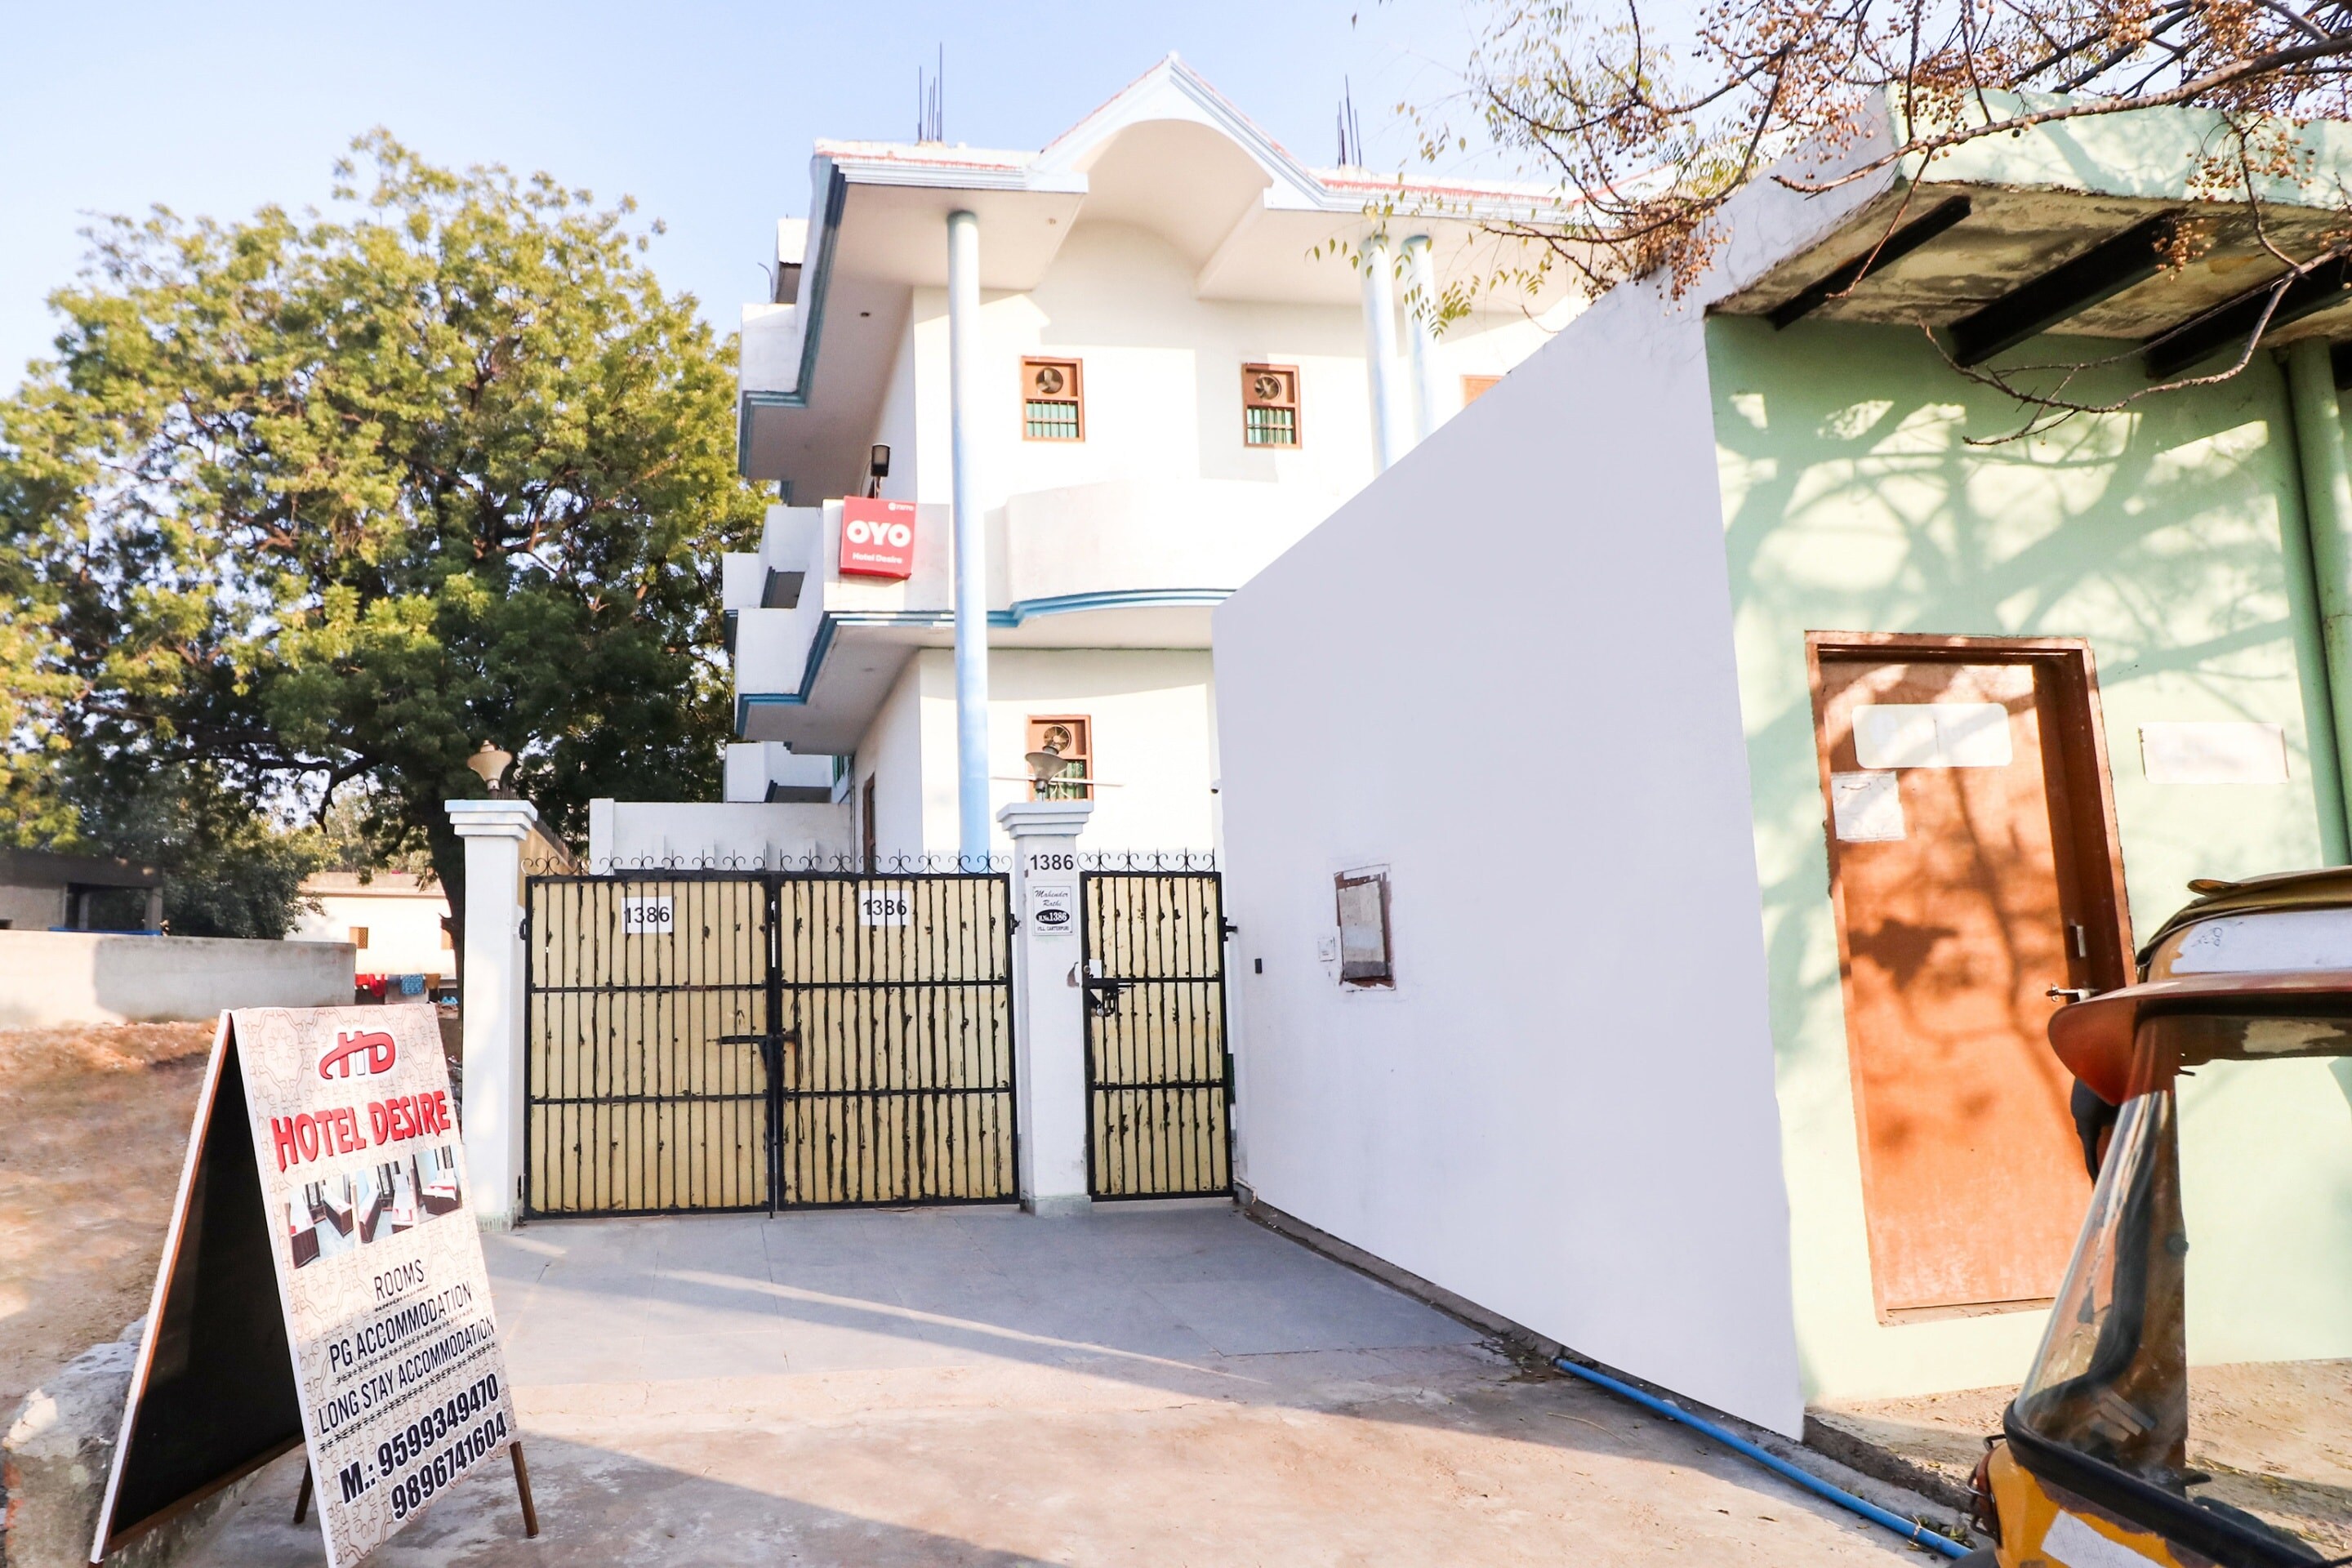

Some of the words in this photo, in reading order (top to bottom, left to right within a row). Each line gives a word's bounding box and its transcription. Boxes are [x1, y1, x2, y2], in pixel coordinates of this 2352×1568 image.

[846, 520, 911, 548] OYO
[852, 552, 875, 562] Hotel
[875, 554, 902, 564] Desire
[1030, 854, 1074, 871] 1386
[624, 906, 670, 924] 1386
[862, 899, 907, 916] 1386
[270, 1107, 367, 1174] HOTEL
[368, 1090, 452, 1146] DESIRE
[374, 1258, 425, 1301] ROOMS
[329, 1337, 353, 1374] PG
[355, 1280, 473, 1360] ACCOMMODATION
[318, 1390, 359, 1435] LONG
[362, 1368, 394, 1410] STAY
[398, 1315, 496, 1390] ACCOMMODATION
[339, 1460, 376, 1504] M.:
[377, 1373, 499, 1477] 9599349470
[391, 1411, 507, 1520] 9896741604
